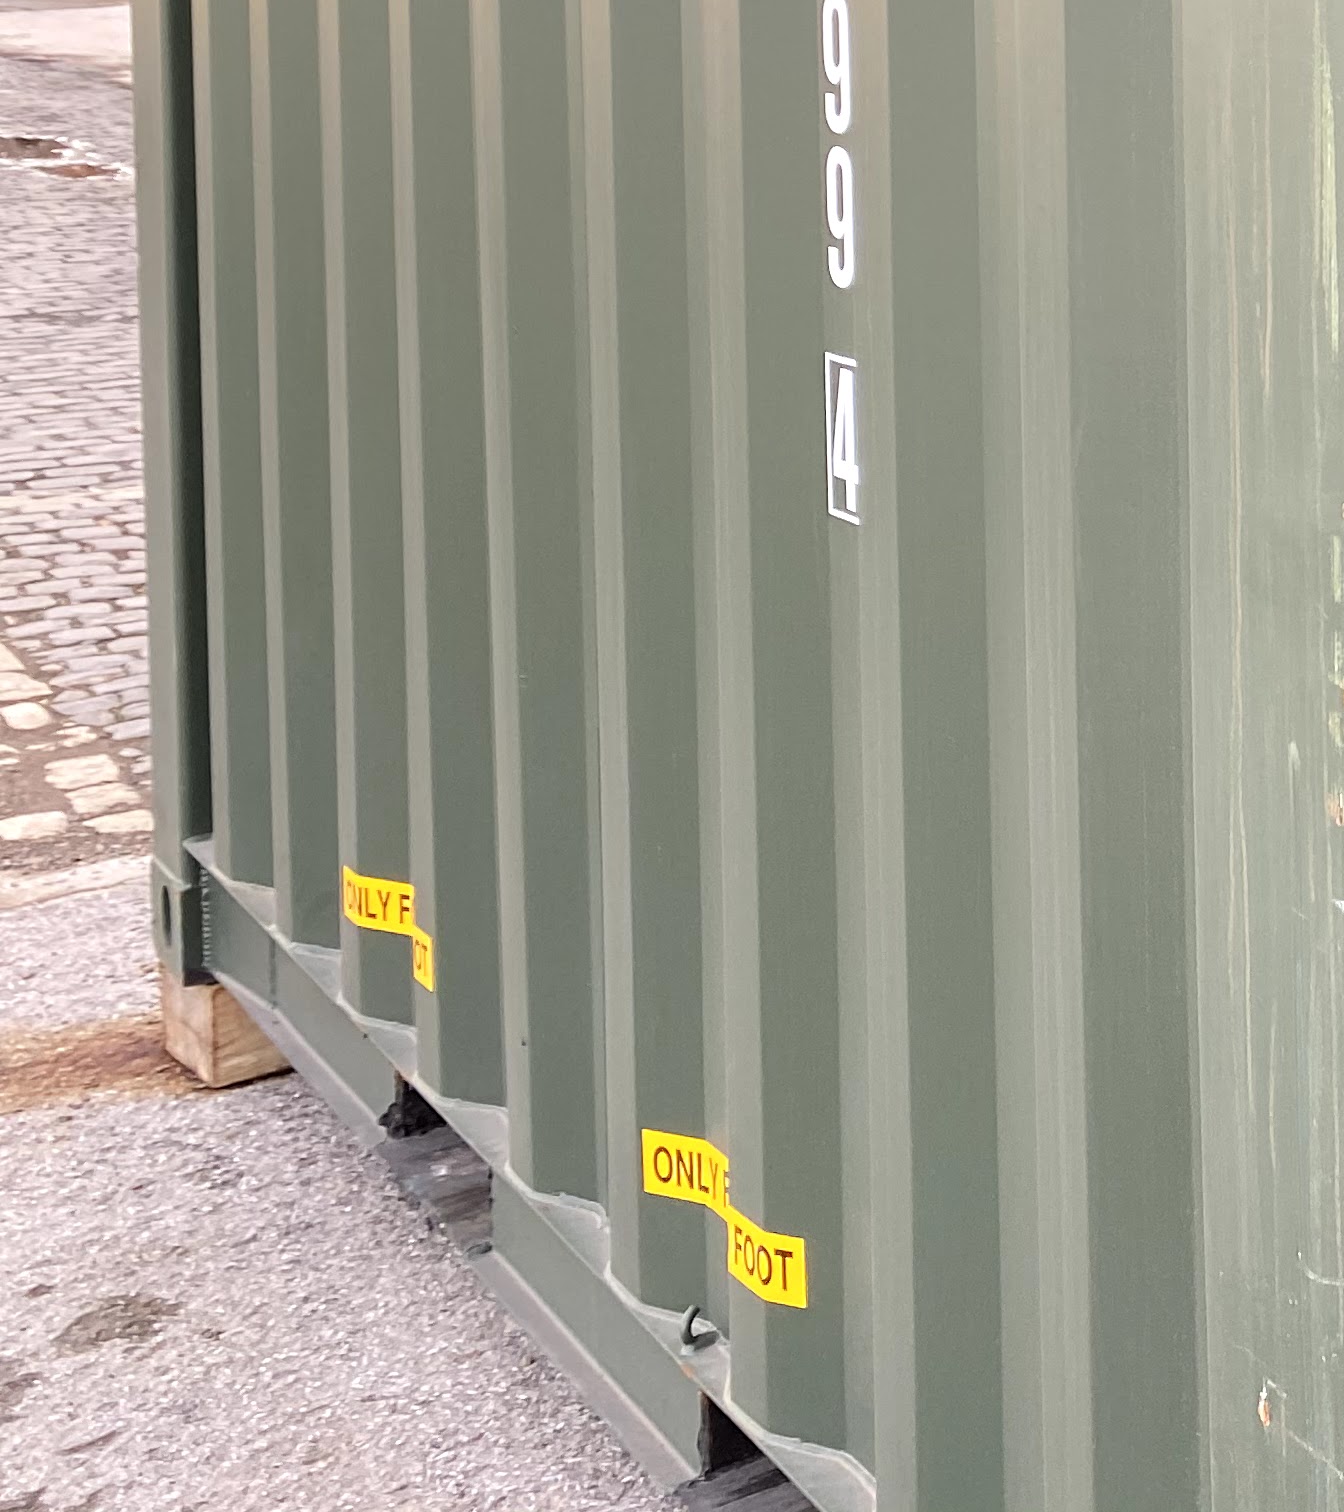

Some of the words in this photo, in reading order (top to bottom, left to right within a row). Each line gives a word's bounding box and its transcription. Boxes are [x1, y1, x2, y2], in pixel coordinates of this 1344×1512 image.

[832, 366, 860, 513] 4
[653, 1146, 719, 1200] ONLY
[734, 1224, 794, 1292] FOOT
